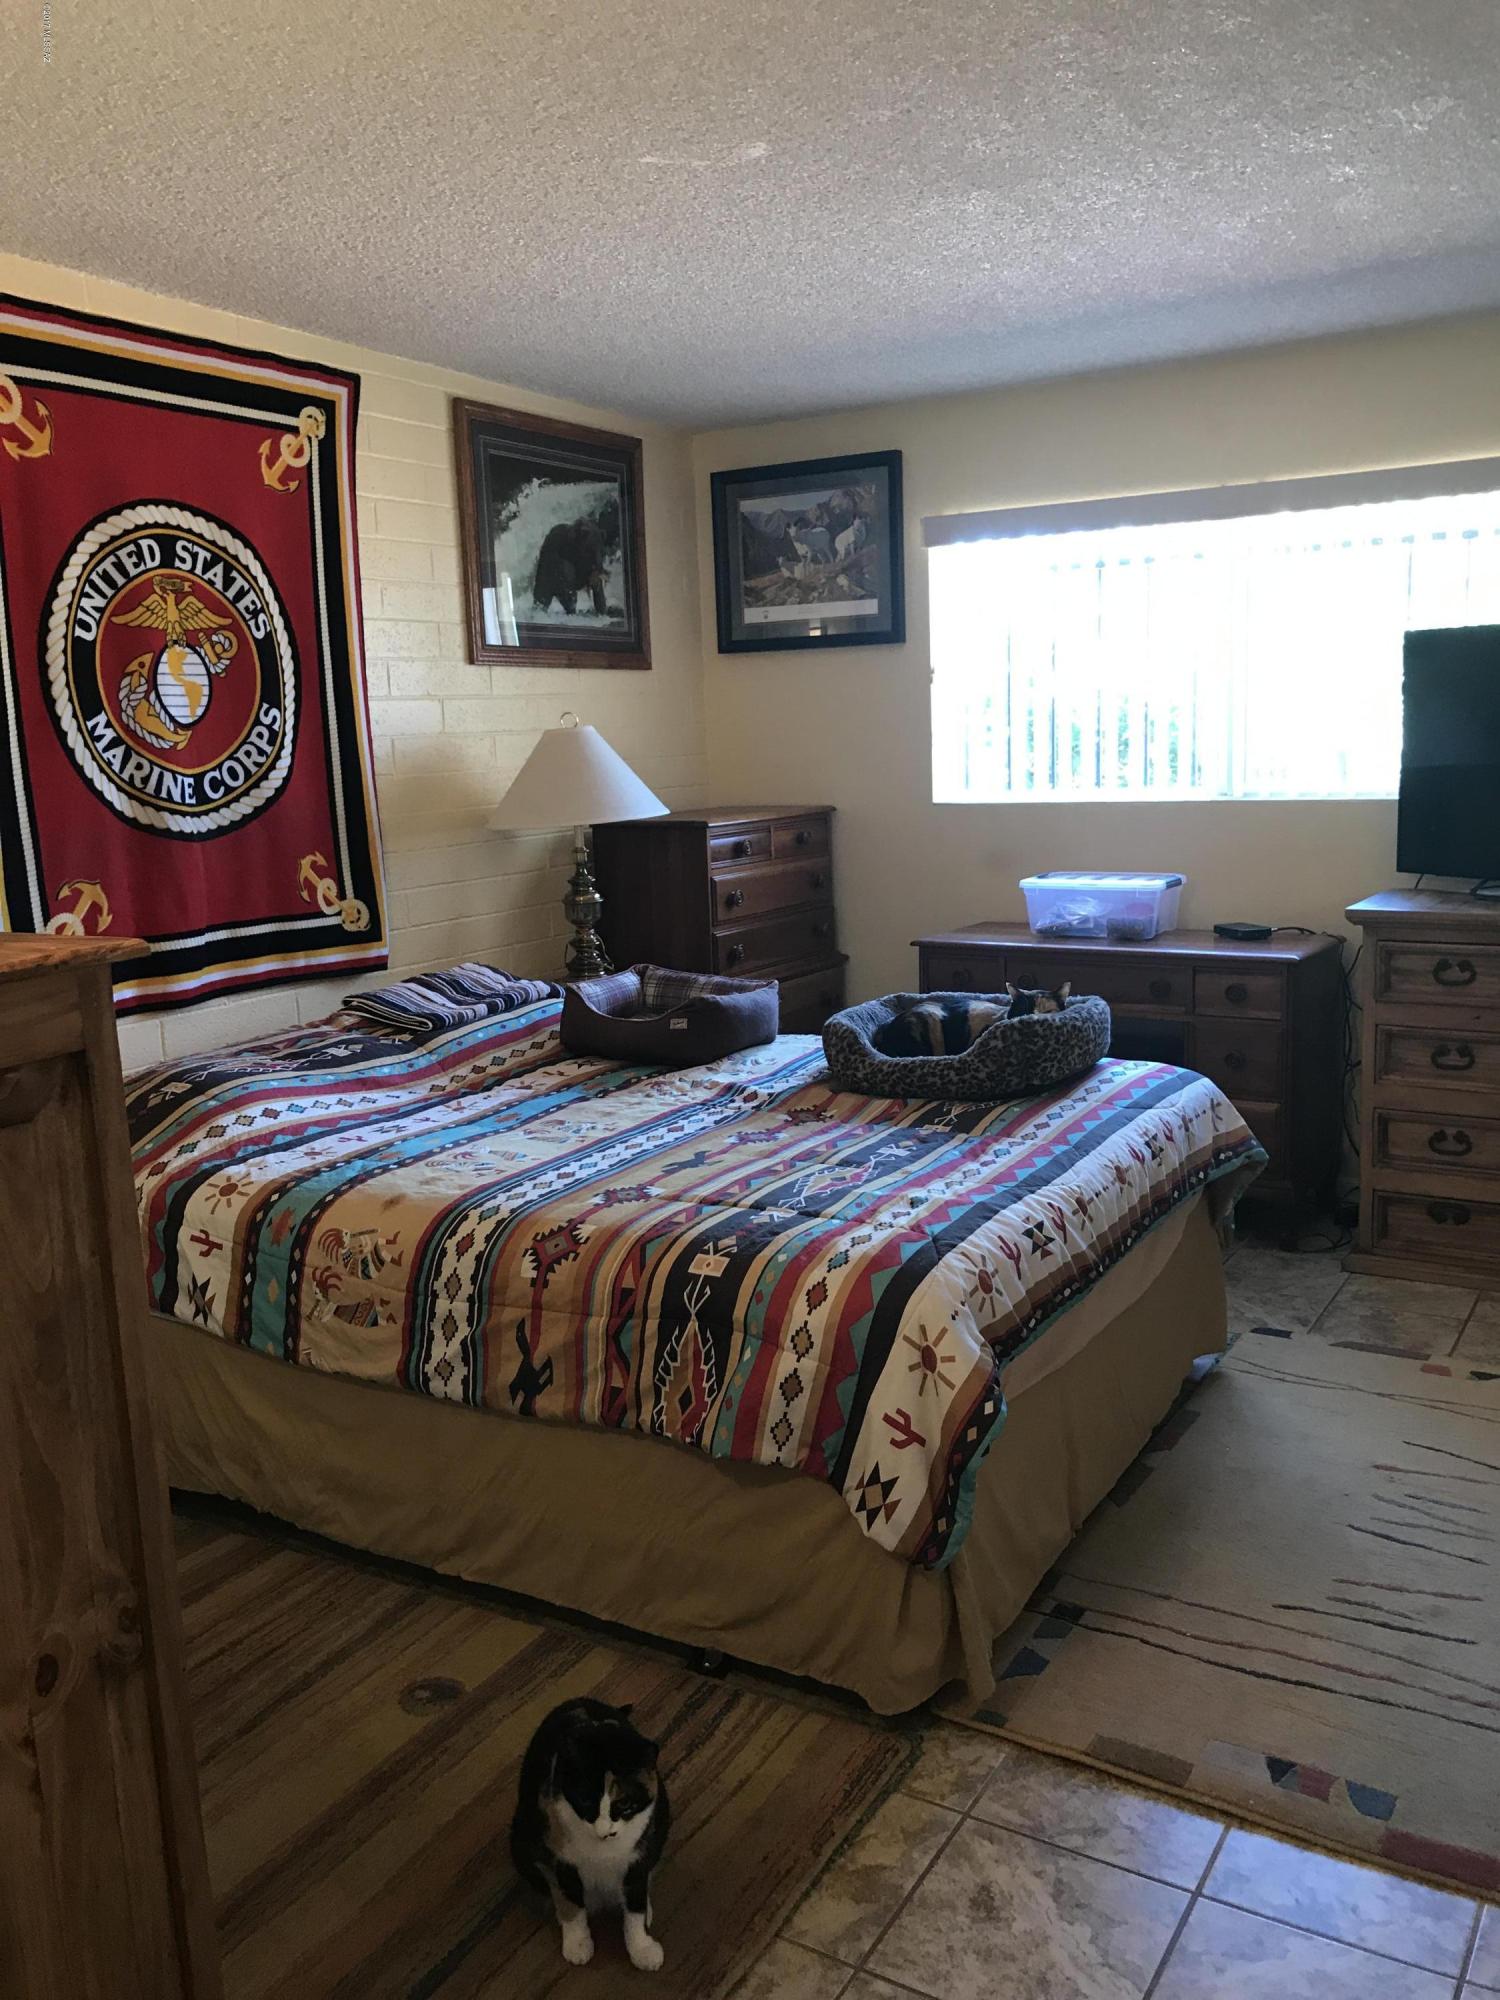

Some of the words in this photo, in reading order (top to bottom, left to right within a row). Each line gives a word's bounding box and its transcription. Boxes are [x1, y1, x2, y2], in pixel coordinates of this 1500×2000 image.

[74, 538, 161, 642] UNITED
[174, 539, 271, 640] STATES
[87, 711, 196, 804] MARINE
[203, 703, 281, 800] CORPS
